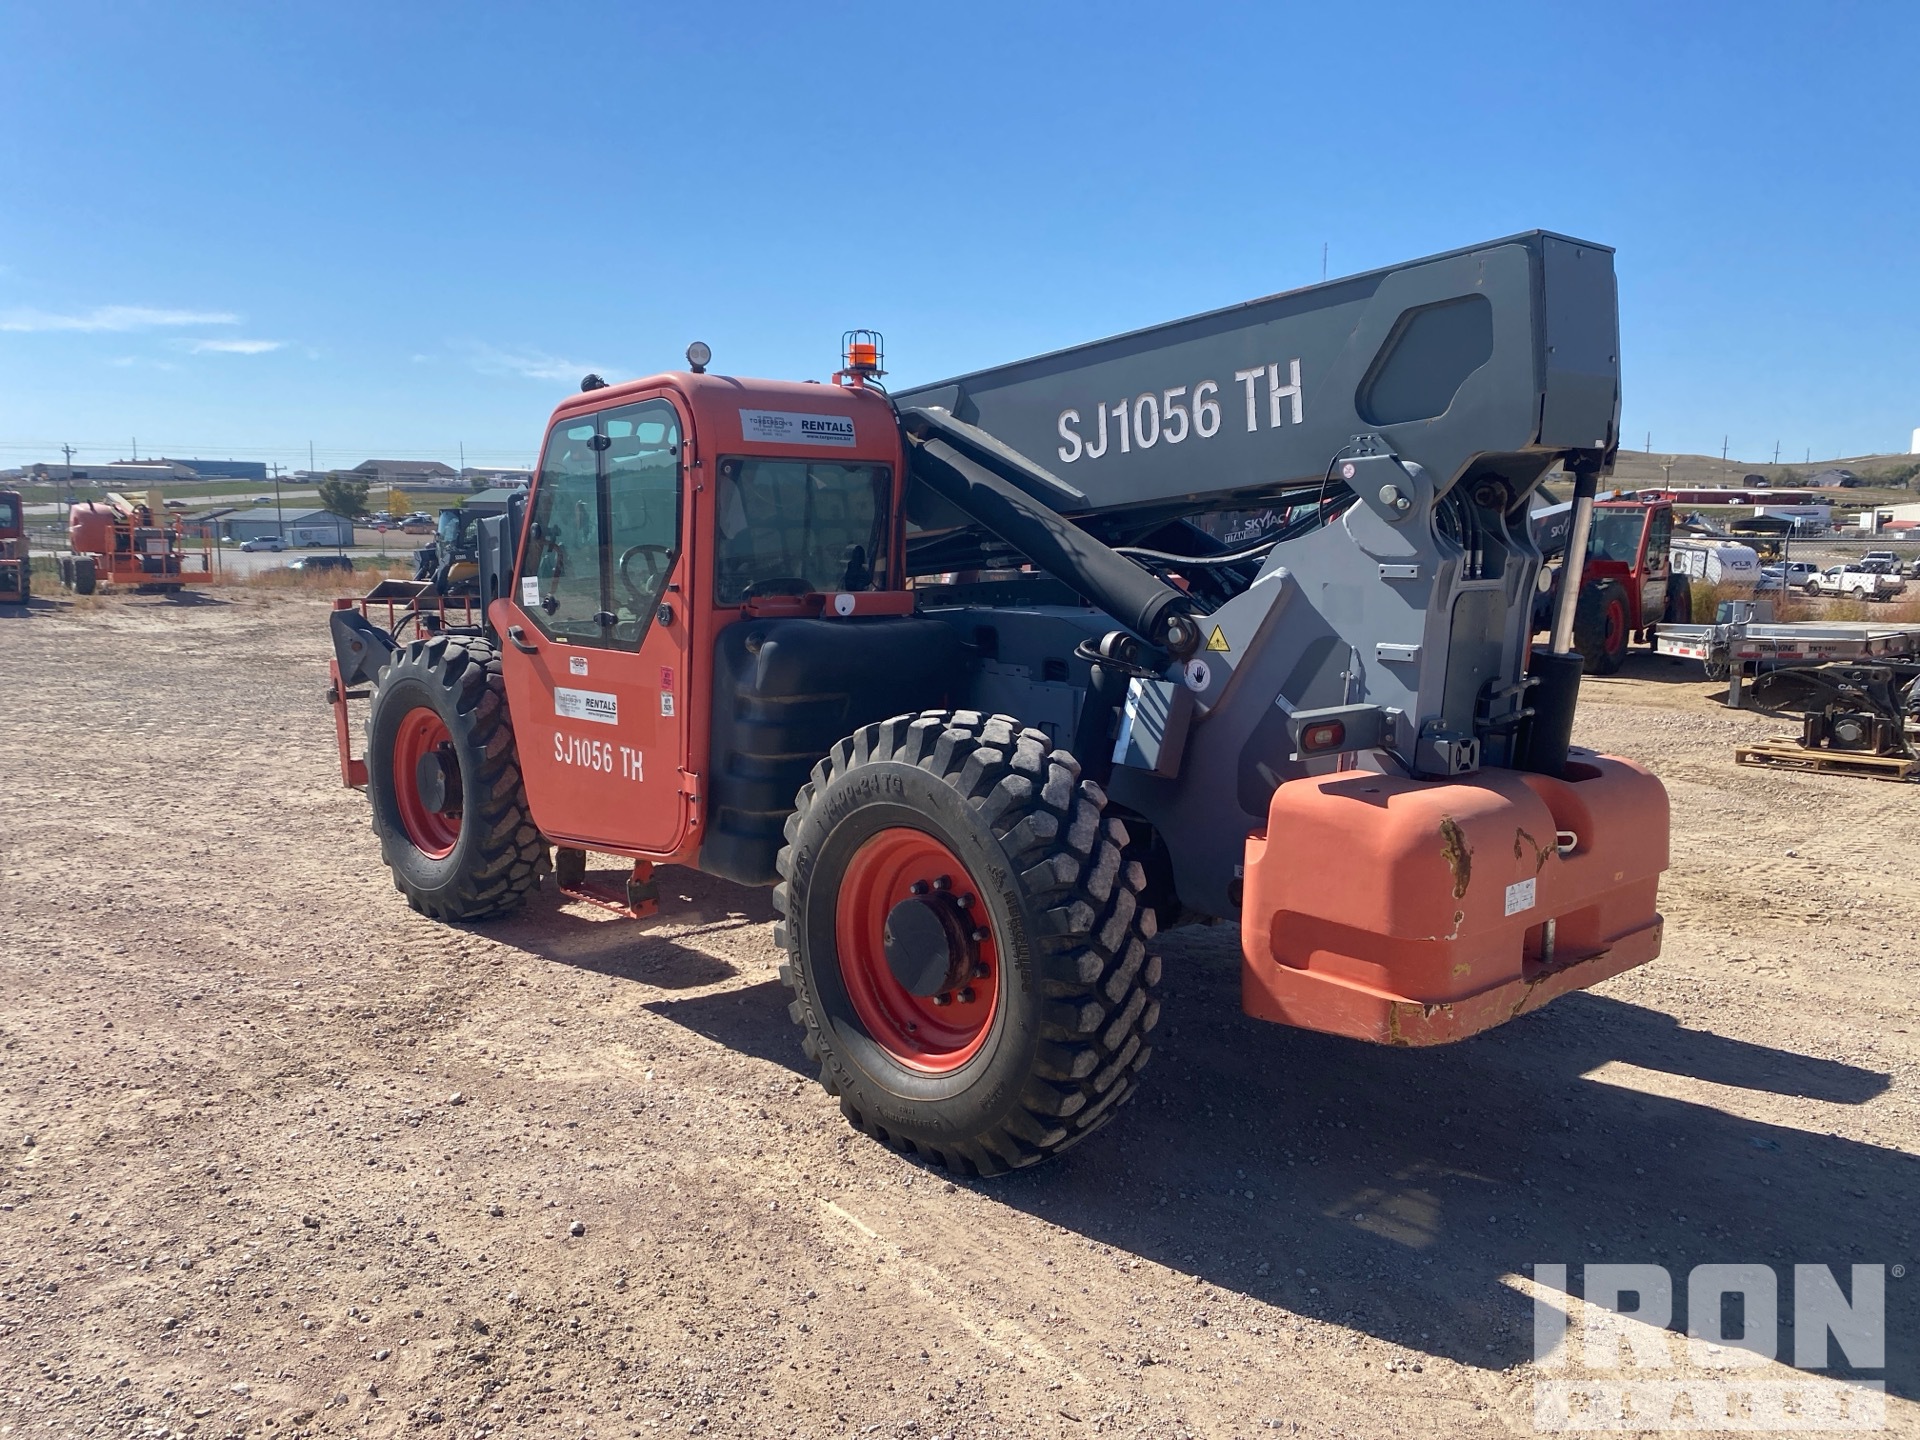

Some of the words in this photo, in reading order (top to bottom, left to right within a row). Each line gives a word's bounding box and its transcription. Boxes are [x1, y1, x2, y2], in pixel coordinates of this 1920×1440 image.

[1058, 380, 1222, 463] SJ1056
[1234, 357, 1303, 433] TH
[801, 419, 853, 433] RENTALS
[1244, 510, 1287, 530] SKYJAC
[1225, 531, 1245, 543] TITAN
[1778, 644, 1795, 652] KING
[585, 698, 616, 711] RENTALS
[554, 732, 613, 773] SJ1056
[620, 746, 644, 783] TH
